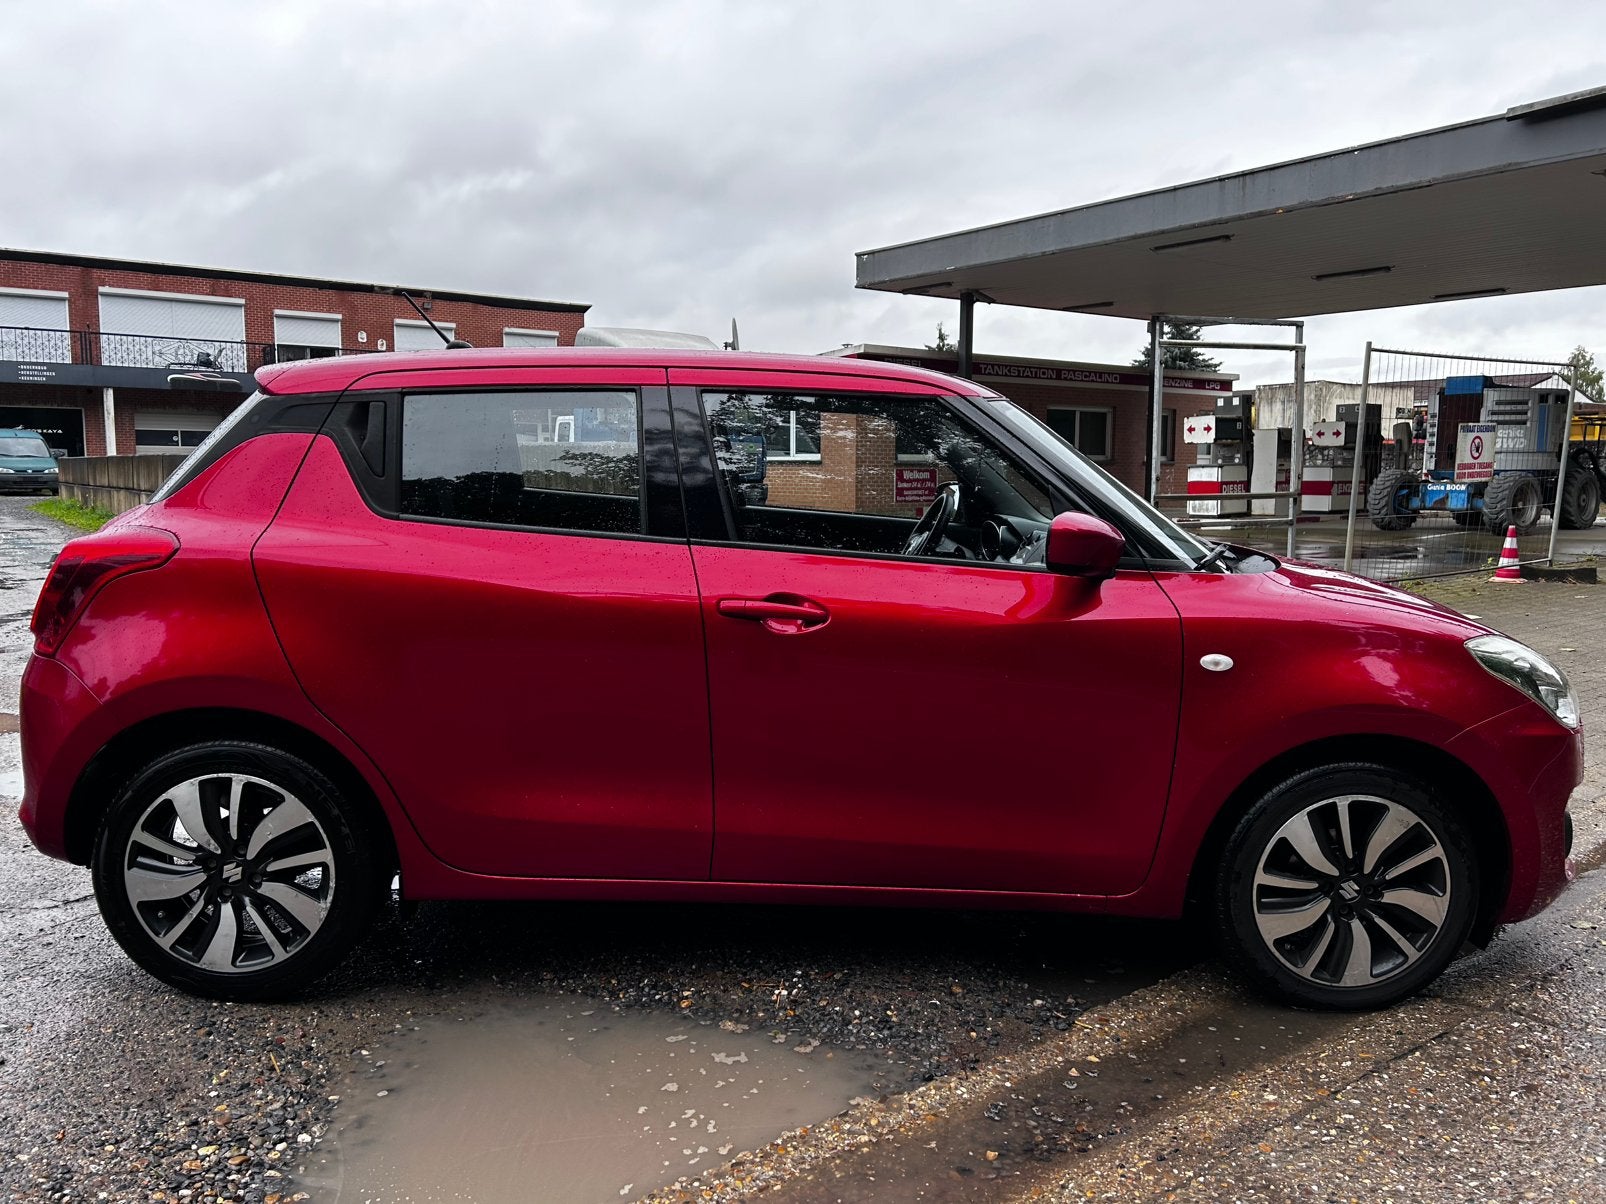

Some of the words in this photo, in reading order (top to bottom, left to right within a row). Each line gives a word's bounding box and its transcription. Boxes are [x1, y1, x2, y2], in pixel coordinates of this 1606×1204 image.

[980, 364, 1056, 379] TANKSTATION
[1061, 370, 1120, 383] PASCALINO
[1163, 379, 1194, 388] ENZINE
[1205, 382, 1220, 390] LPG
[903, 470, 930, 479] Welkom
[1222, 484, 1246, 493] DIESEL
